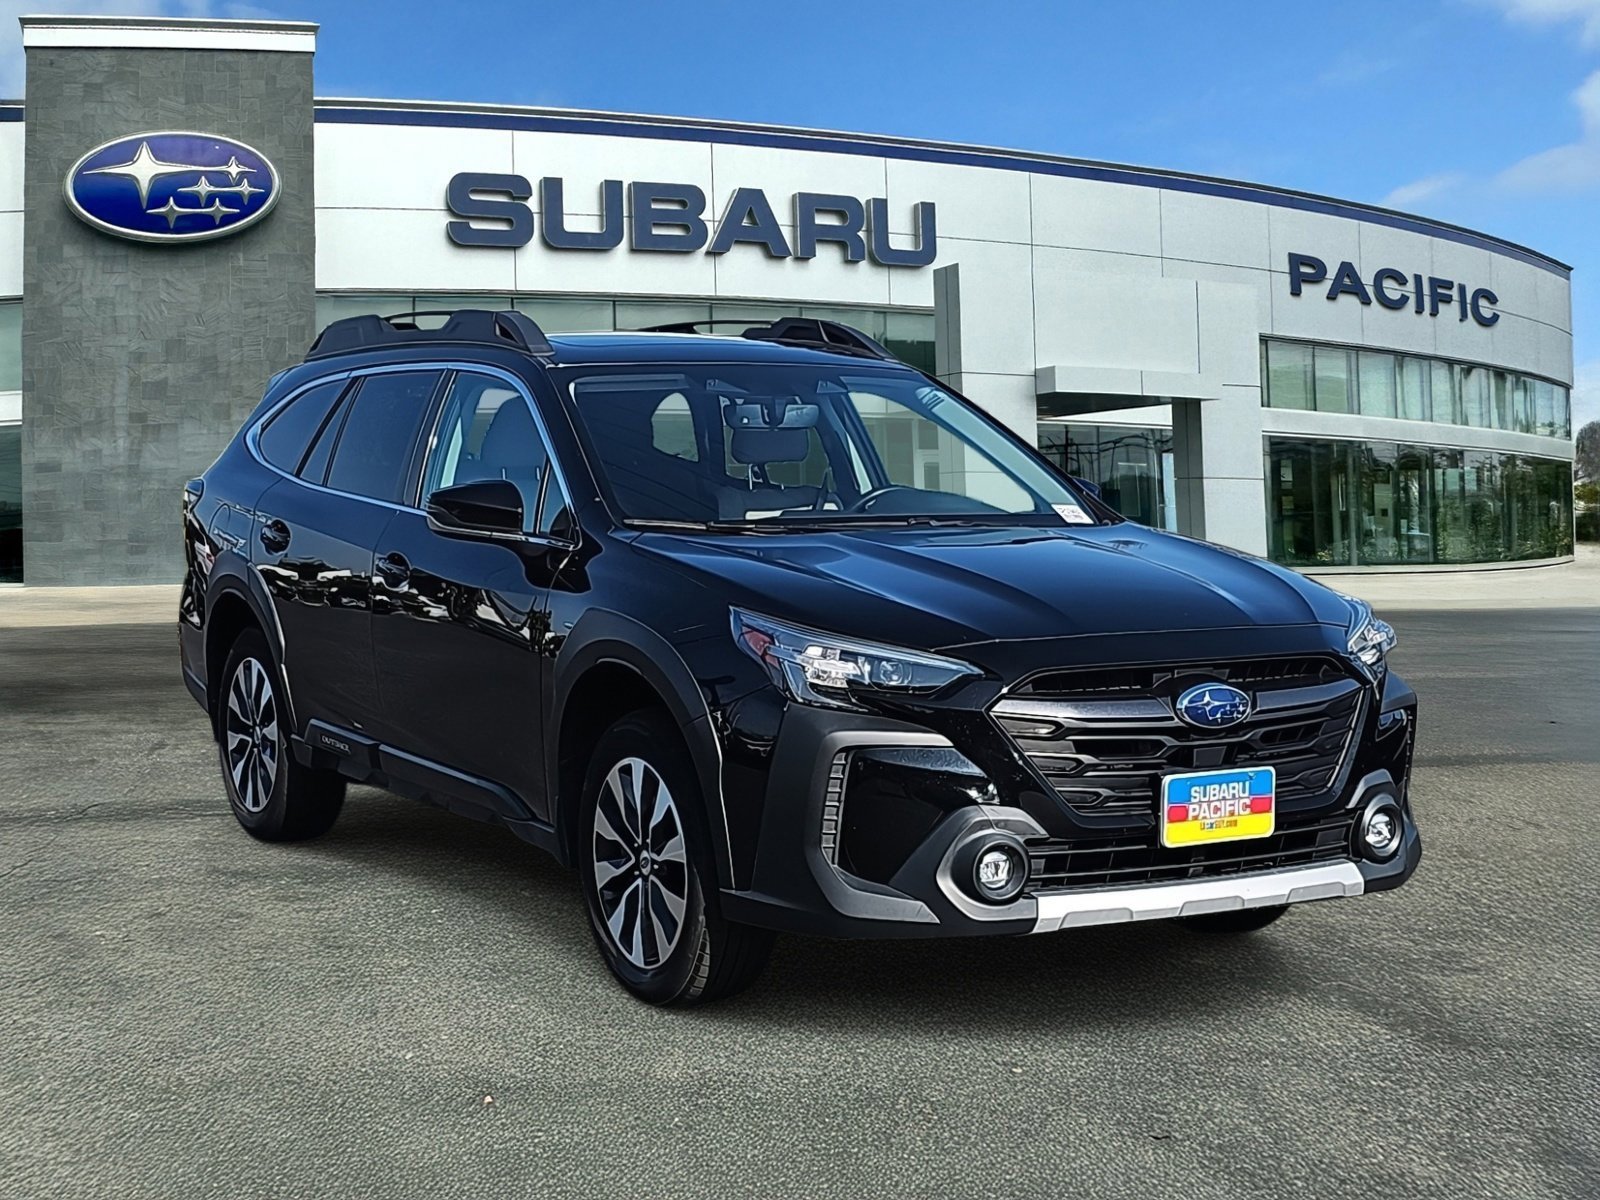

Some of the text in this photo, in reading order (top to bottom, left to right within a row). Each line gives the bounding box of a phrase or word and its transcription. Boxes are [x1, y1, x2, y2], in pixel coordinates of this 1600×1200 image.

[447, 171, 937, 268] SUBARU
[1288, 252, 1500, 327] PACIFIC
[1187, 798, 1252, 821] PACIFIC
[1190, 781, 1250, 803] SUBARU
